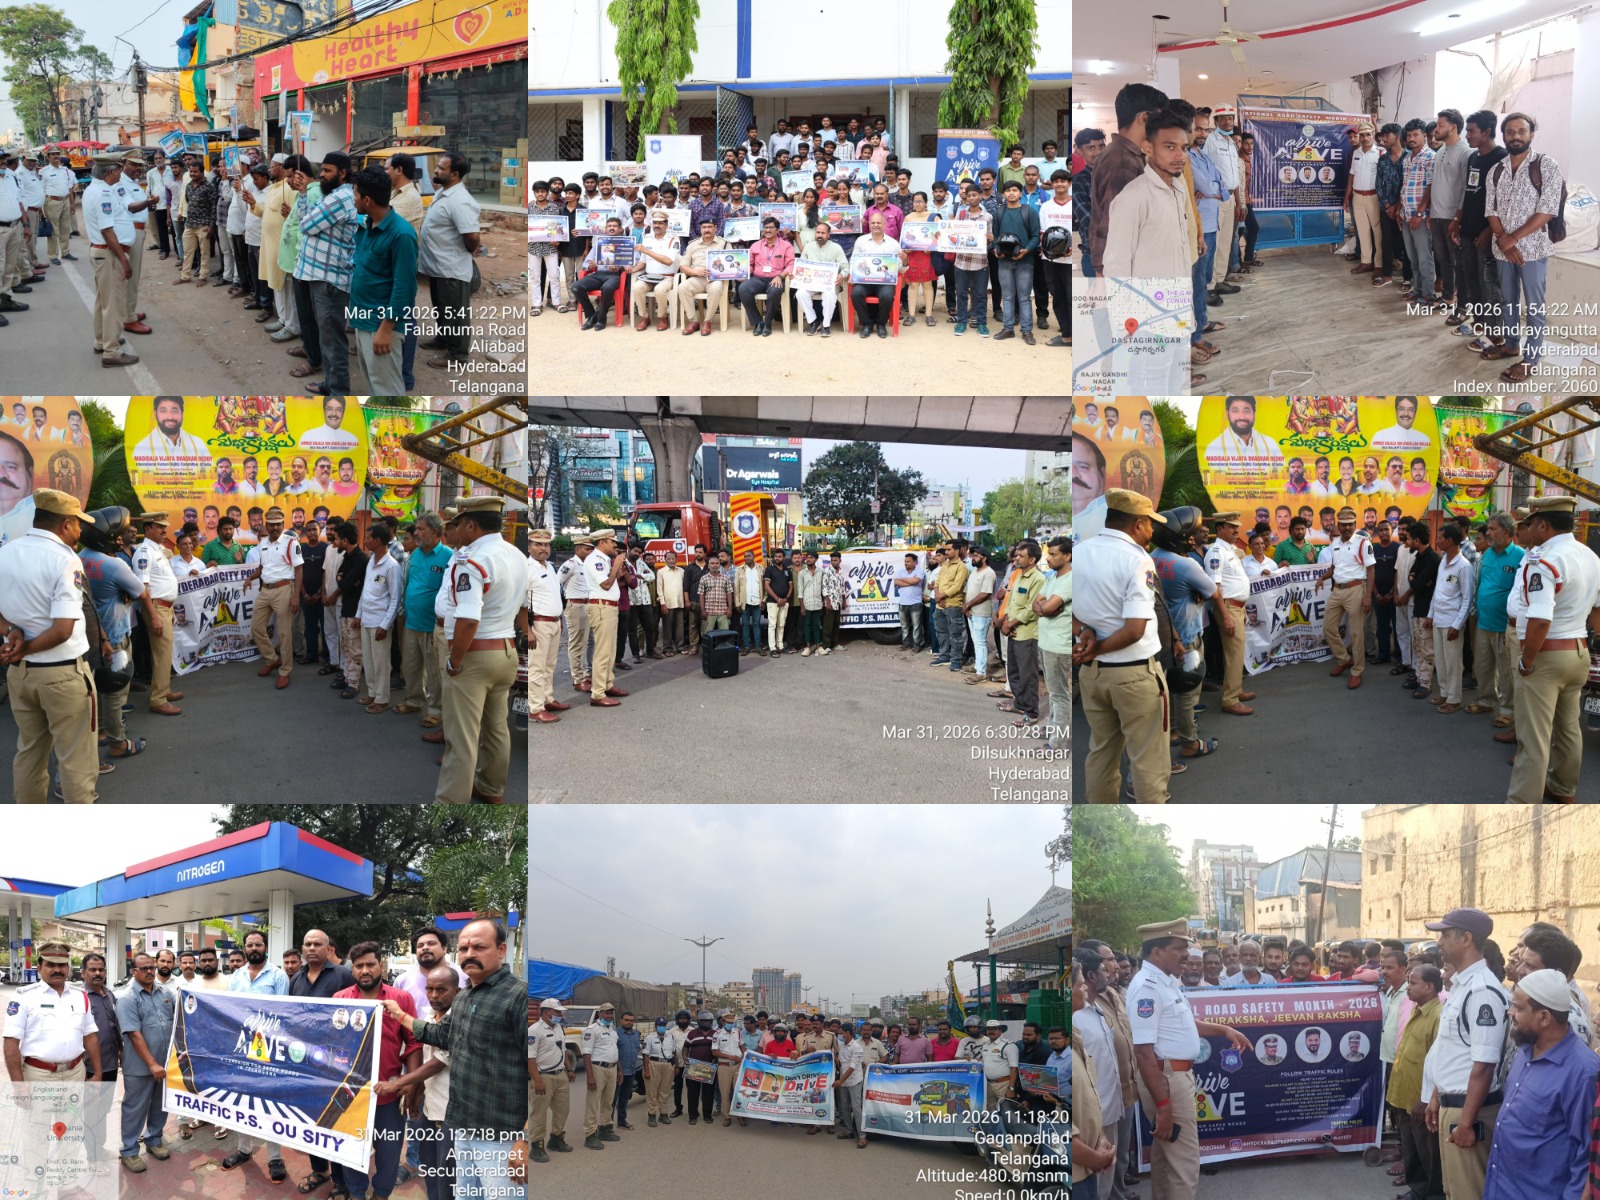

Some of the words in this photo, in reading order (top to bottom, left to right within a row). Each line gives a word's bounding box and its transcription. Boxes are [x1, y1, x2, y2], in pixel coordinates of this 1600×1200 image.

[324, 17, 419, 61] Healthy
[331, 43, 398, 77] Heart
[1285, 137, 1332, 149] arrive
[726, 469, 737, 478] Dr
[738, 469, 779, 480] Agarwals
[219, 570, 239, 581] CITY
[849, 561, 894, 580] arrive
[1291, 570, 1311, 581] CITY
[203, 587, 240, 609] arrive
[1275, 587, 1312, 609] arrive
[177, 859, 225, 883] NITROGEN
[1205, 1003, 1237, 1015] ROAD
[1242, 1001, 1284, 1014] SAFETY
[1294, 1000, 1334, 1012] MONTH
[1349, 998, 1377, 1009] 2026
[1272, 1011, 1314, 1023] JEEVAN
[1318, 1010, 1361, 1020] RAKSHA
[244, 1009, 281, 1032] arrive
[174, 1093, 231, 1120] TRAFFIC
[235, 1111, 262, 1130] P.S.
[272, 1121, 297, 1139] OU
[302, 1129, 345, 1152] SITY
